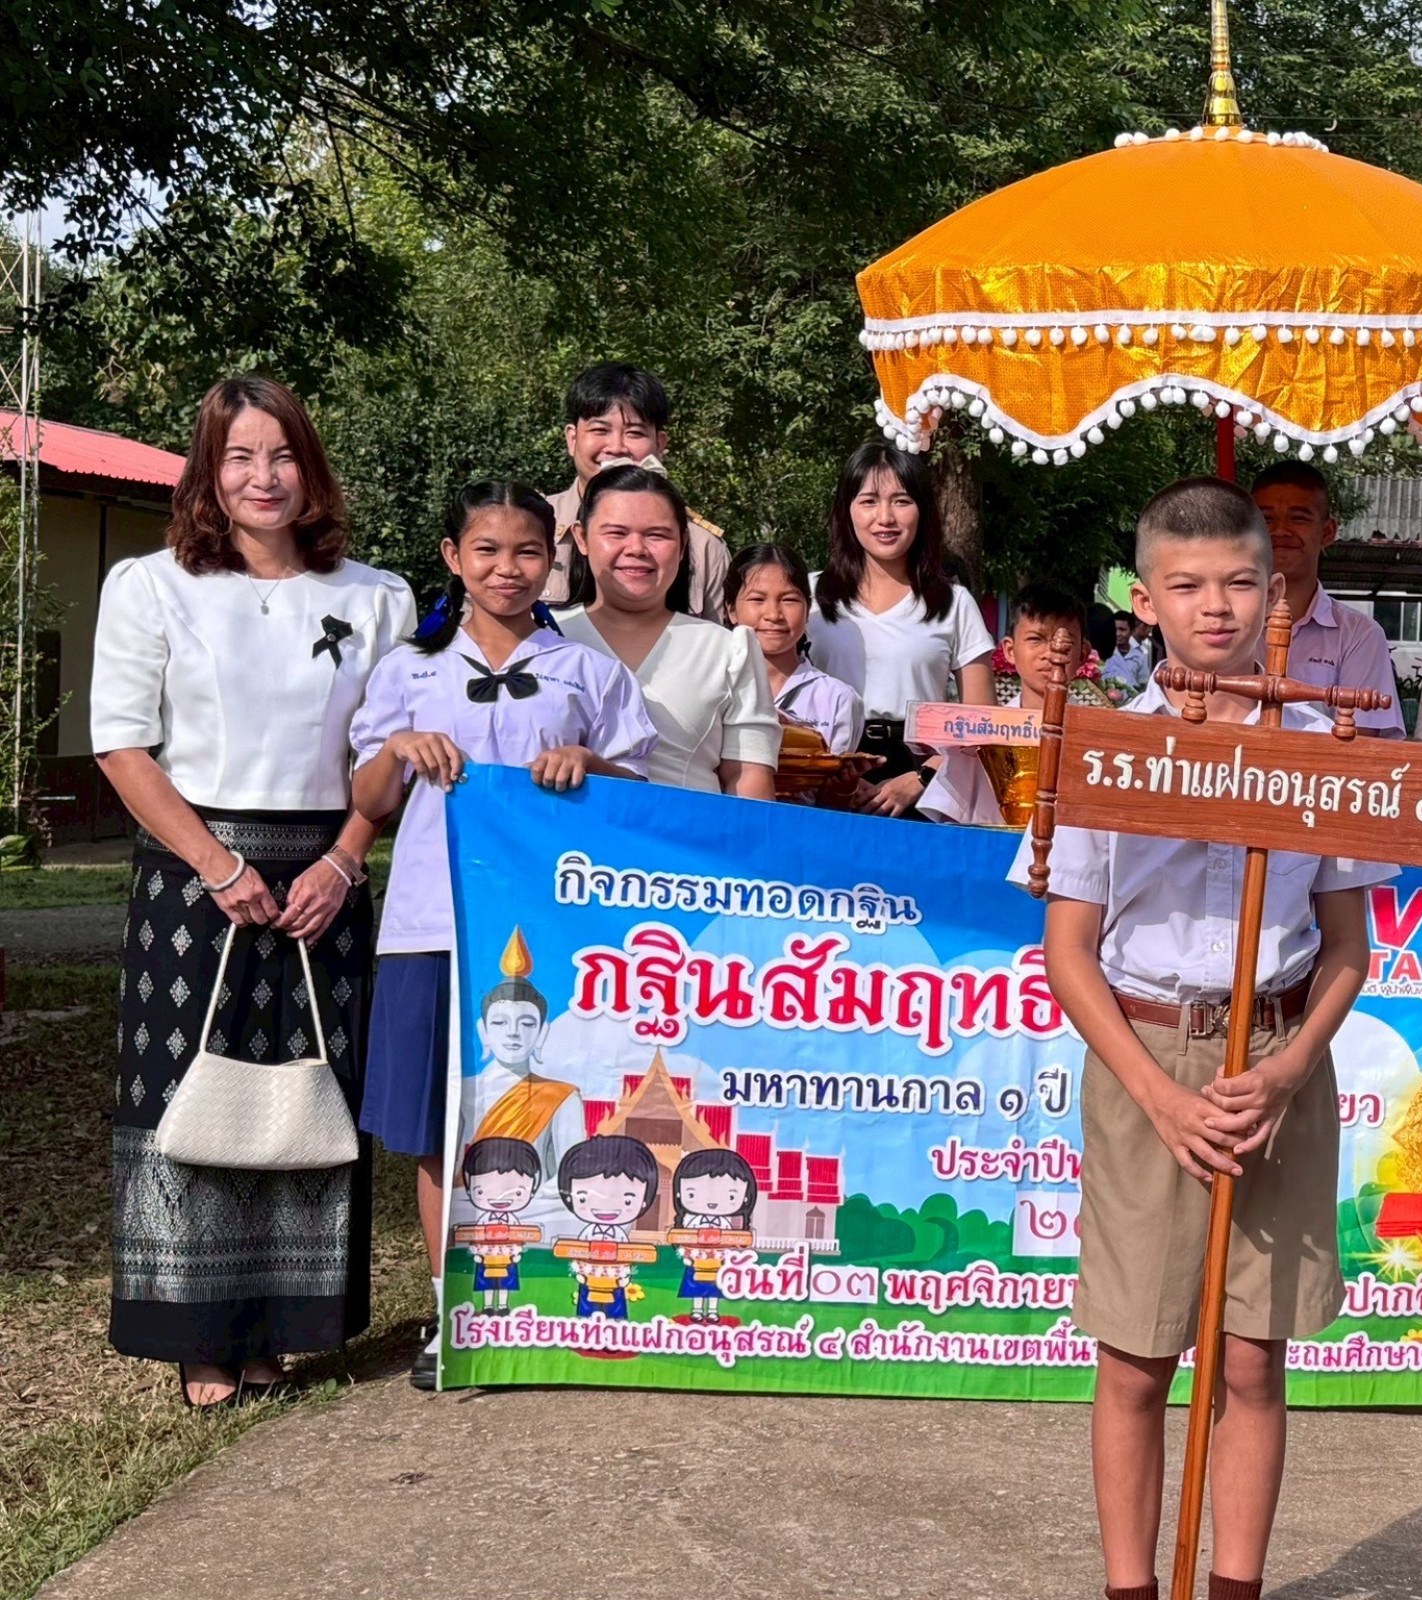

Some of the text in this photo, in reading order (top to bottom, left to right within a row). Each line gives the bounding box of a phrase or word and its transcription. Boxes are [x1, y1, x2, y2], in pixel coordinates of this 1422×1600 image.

[1081, 735, 1411, 829] ร.ร.ท่าแฝกอนุสรณ์
[559, 855, 917, 930] กิจกรรมทอดกฐิน
[723, 1068, 1068, 1116] มหาทานกาล ๑ ปี
[721, 1245, 804, 1297] วันที่
[453, 1308, 808, 1364] โรงเรียนท่าแฝกอนุสรณ์
[851, 1320, 1098, 1362] สำนักงานเขตพื้น
